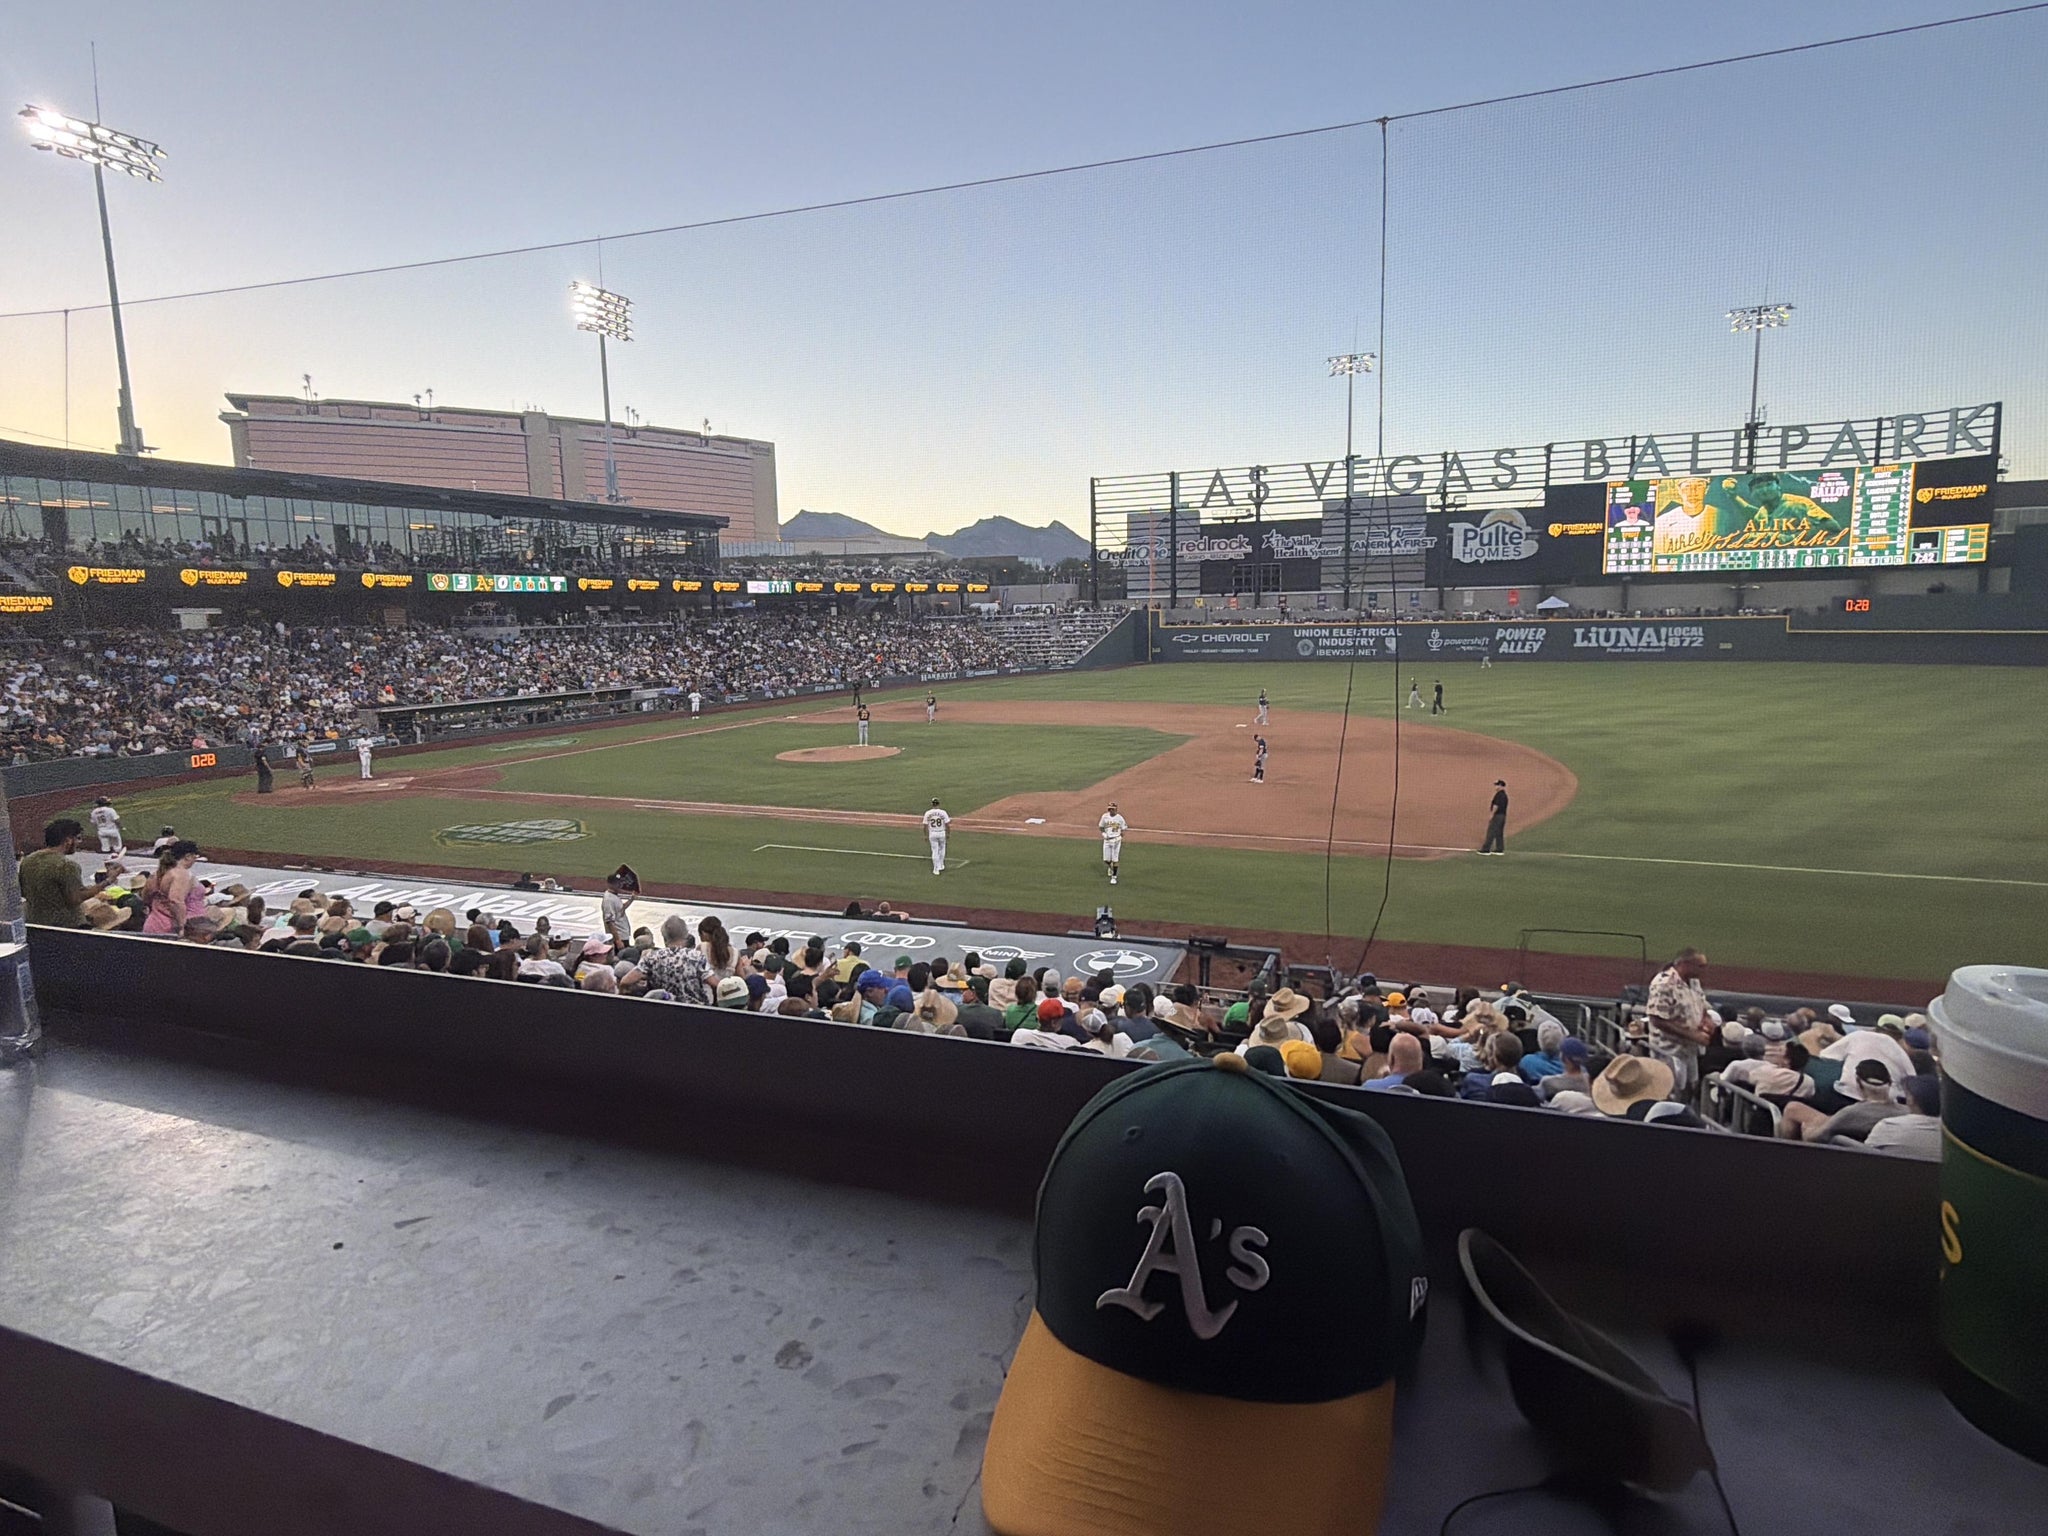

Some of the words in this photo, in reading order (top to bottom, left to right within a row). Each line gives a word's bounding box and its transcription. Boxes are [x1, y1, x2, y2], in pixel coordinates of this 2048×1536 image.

[1173, 466, 1269, 508] LAS
[1304, 448, 1518, 499] VEGAS
[1583, 403, 1996, 480] BALLPARK
[1810, 486, 1850, 498] BALLOT
[1934, 484, 1988, 496] FRIEDMAN
[1563, 523, 1603, 531] FRIEDMAN
[1744, 517, 1811, 533] ALIKA
[1463, 524, 1524, 547] Pulte
[1275, 538, 1291, 547] The
[1291, 535, 1322, 549] Valley
[1353, 539, 1401, 550] AMERICA
[1404, 538, 1437, 549] FIRST
[1275, 547, 1308, 558] Health
[1310, 547, 1340, 559] System
[1462, 547, 1522, 559] HOMES
[90, 568, 146, 578] FRIEDMAN
[199, 571, 248, 580] FRIEDMAN
[294, 572, 336, 582] FRIEDMAN
[376, 574, 412, 584] FRIEDMAN
[457, 576, 467, 589] 3
[474, 575, 494, 591] A's
[497, 577, 508, 589] 0
[1845, 599, 1870, 611] 0:28
[1293, 629, 1330, 637] UNION
[1332, 628, 1402, 637] ELECTRICAL
[1495, 628, 1547, 641] POWER
[1574, 626, 1667, 648] LiUNA!
[1668, 626, 1704, 636] LOCAL
[1202, 633, 1271, 643] CHEVROLET
[1318, 637, 1375, 646] INDUSTRY
[1443, 636, 1490, 647] powershift
[1667, 636, 1704, 647] 872
[1499, 641, 1542, 654] ALLEY
[930, 818, 942, 828] 28
[729, 925, 819, 940] GMC
[983, 950, 1018, 960] MINI
[1096, 1171, 1270, 1340] A's
